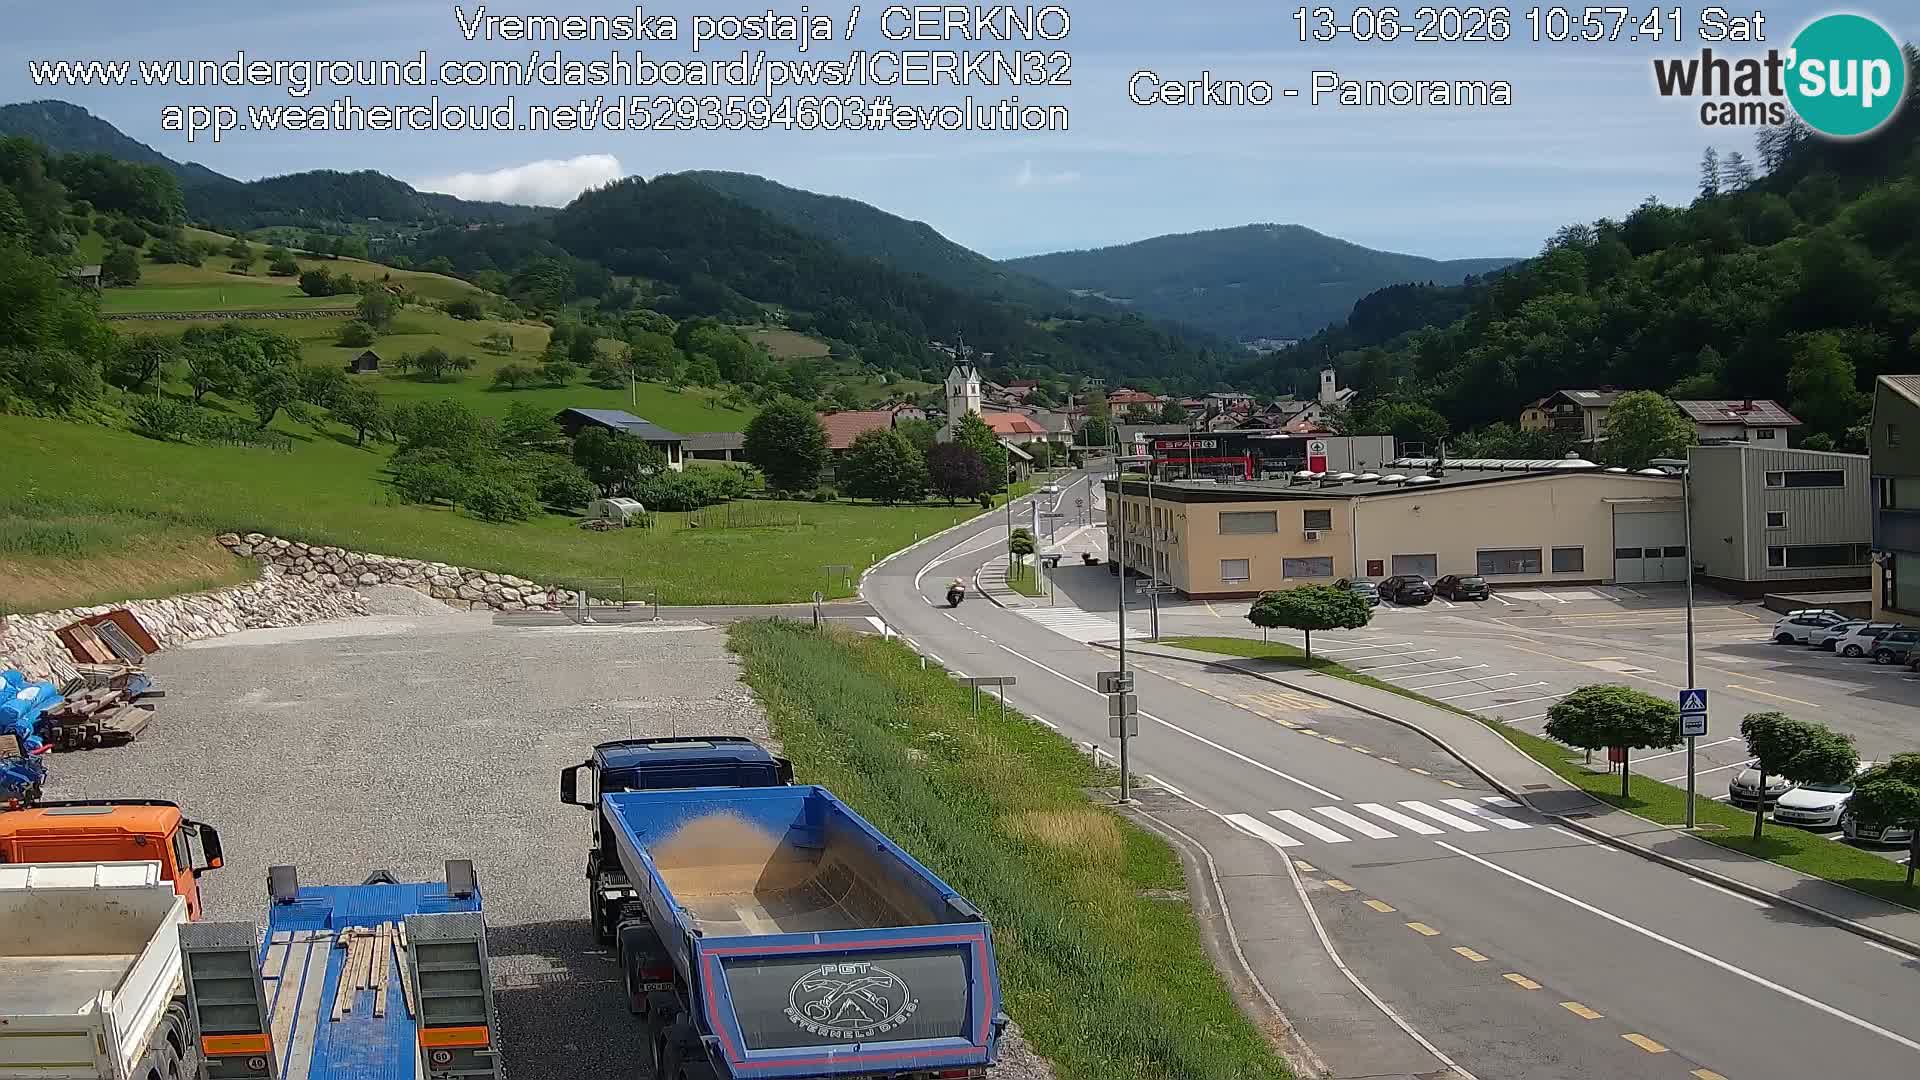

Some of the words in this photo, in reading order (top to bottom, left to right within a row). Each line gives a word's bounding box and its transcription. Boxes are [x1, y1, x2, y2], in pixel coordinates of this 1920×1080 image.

[1165, 441, 1202, 449] SPAR
[820, 962, 871, 976] PGT
[783, 1006, 875, 1039] PETERNELJ
[435, 1052, 448, 1061] 60
